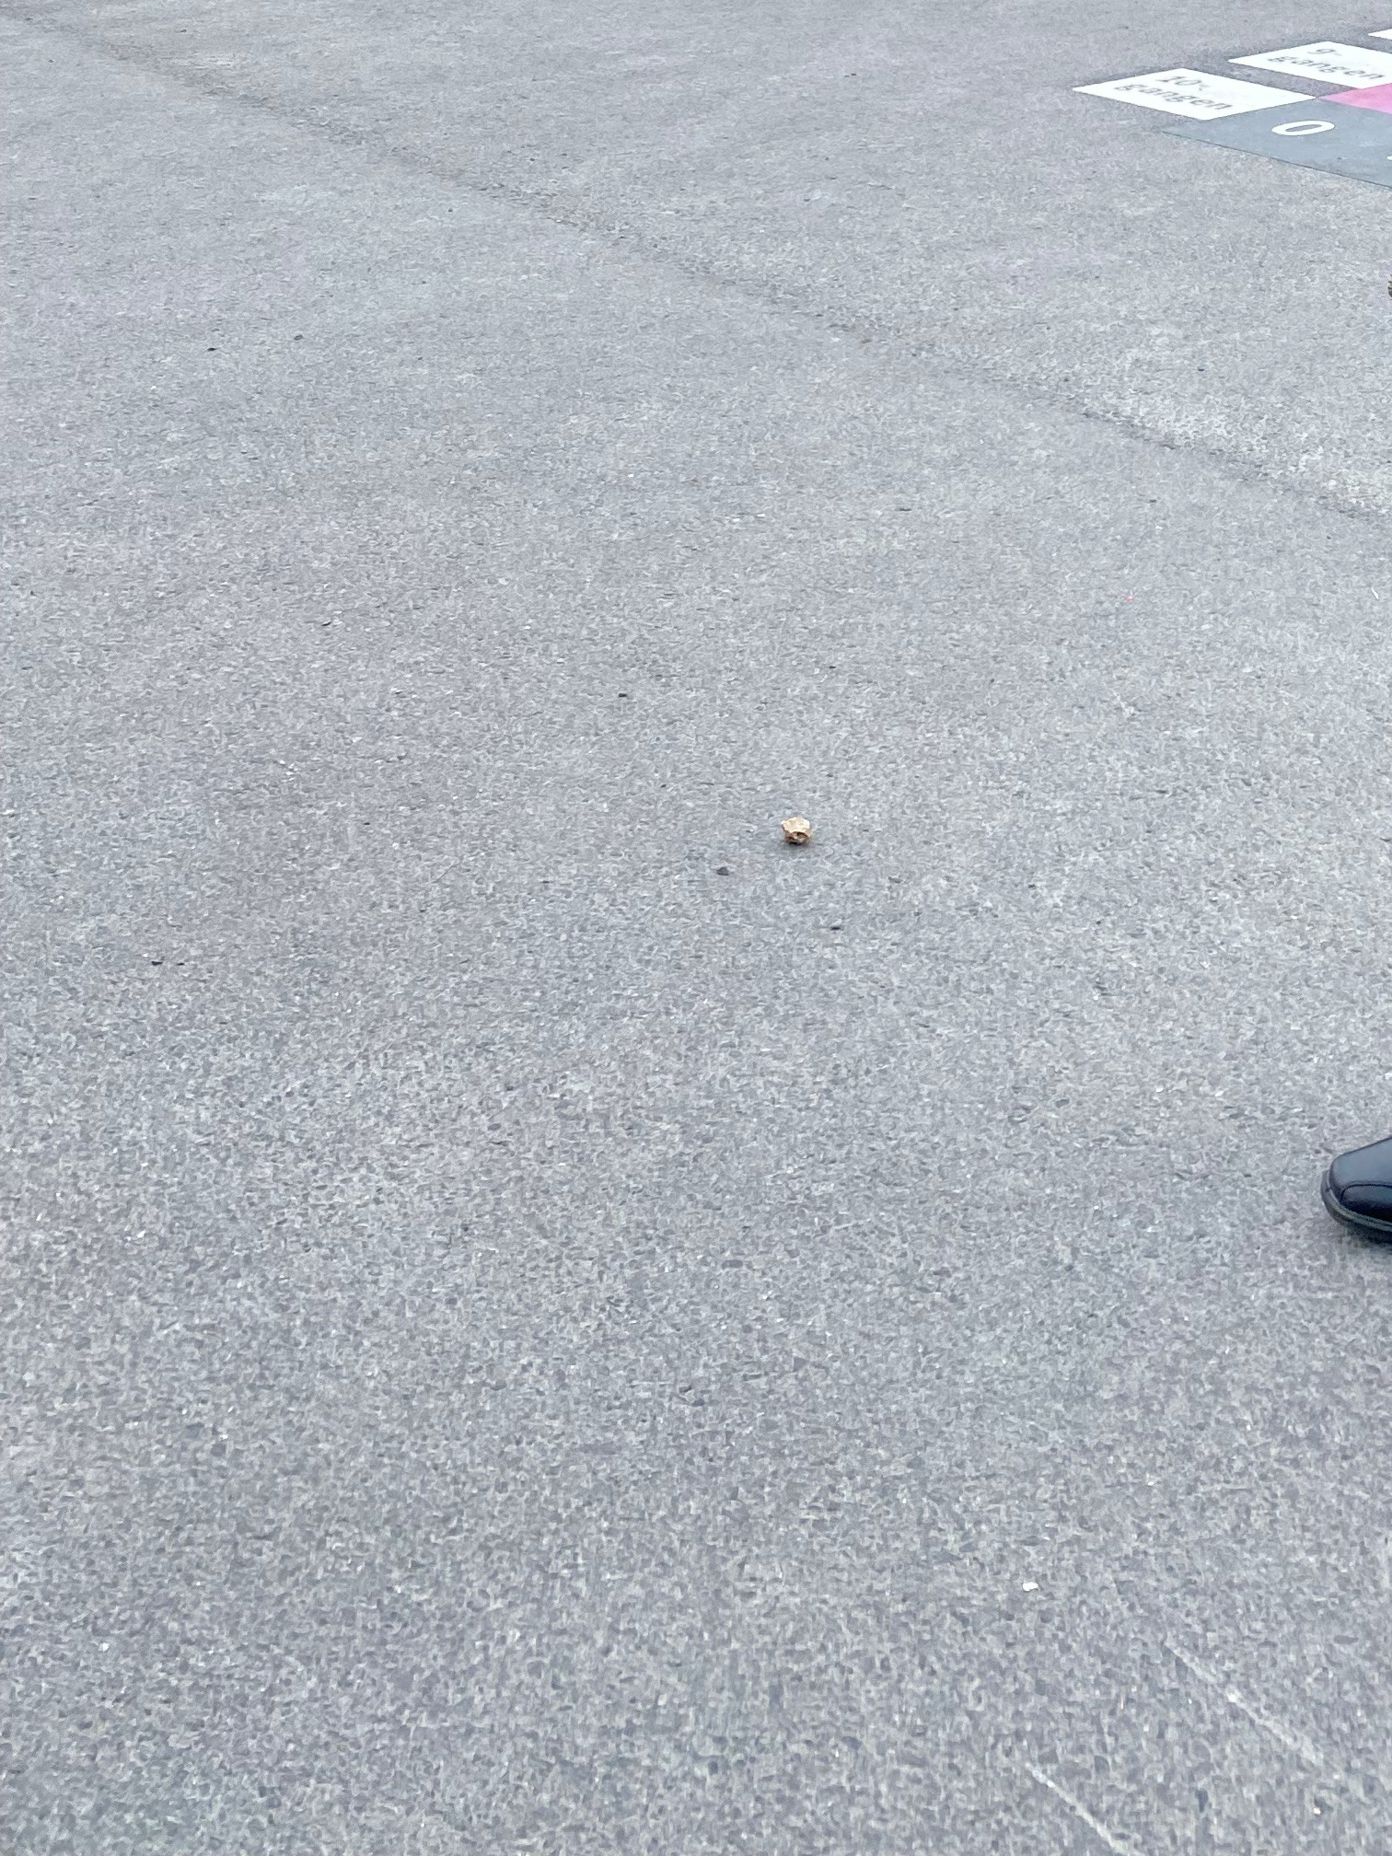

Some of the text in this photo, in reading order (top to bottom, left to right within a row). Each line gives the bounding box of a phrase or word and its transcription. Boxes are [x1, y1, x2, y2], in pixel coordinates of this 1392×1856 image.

[1267, 55, 1385, 80] gangen
[1113, 83, 1233, 111] gangen
[1271, 120, 1336, 137] 0
